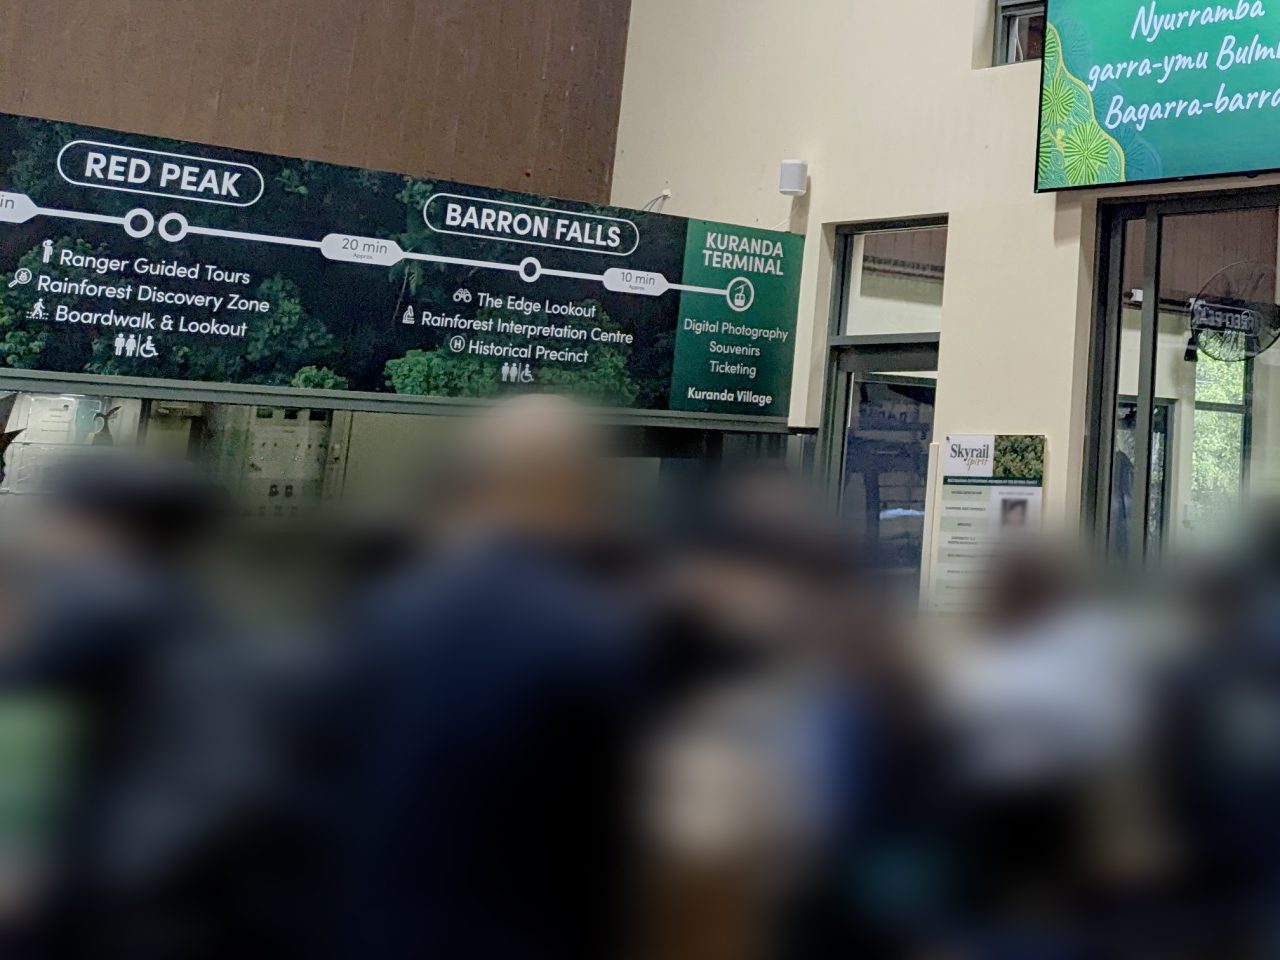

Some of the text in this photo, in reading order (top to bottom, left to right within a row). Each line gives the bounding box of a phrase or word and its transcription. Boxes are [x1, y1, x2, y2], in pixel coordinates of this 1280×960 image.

[1088, 53, 1207, 92] garra-ymu
[85, 153, 241, 198] RED PEAK
[445, 203, 620, 247] BARRON FALLS
[342, 238, 388, 254] 20 min
[706, 232, 783, 258] KURANDA
[60, 249, 251, 285] Ranger Guided Tours
[703, 250, 784, 276] TERMINAL
[621, 272, 655, 286] 10 min
[37, 275, 270, 313] Rainforest Discovery Zone
[478, 292, 596, 319] The Edge Lookout
[56, 305, 248, 338] Boardwalk & Lookout
[421, 311, 634, 345] Rainforest Interpretation Centre
[684, 318, 788, 342] Digital Photography
[469, 340, 589, 363] Historical Precinct
[710, 341, 760, 357] Souvenirs
[710, 360, 756, 379] Ticketing
[688, 387, 772, 407] Kuranda Village
[950, 444, 990, 461] Skyrail
